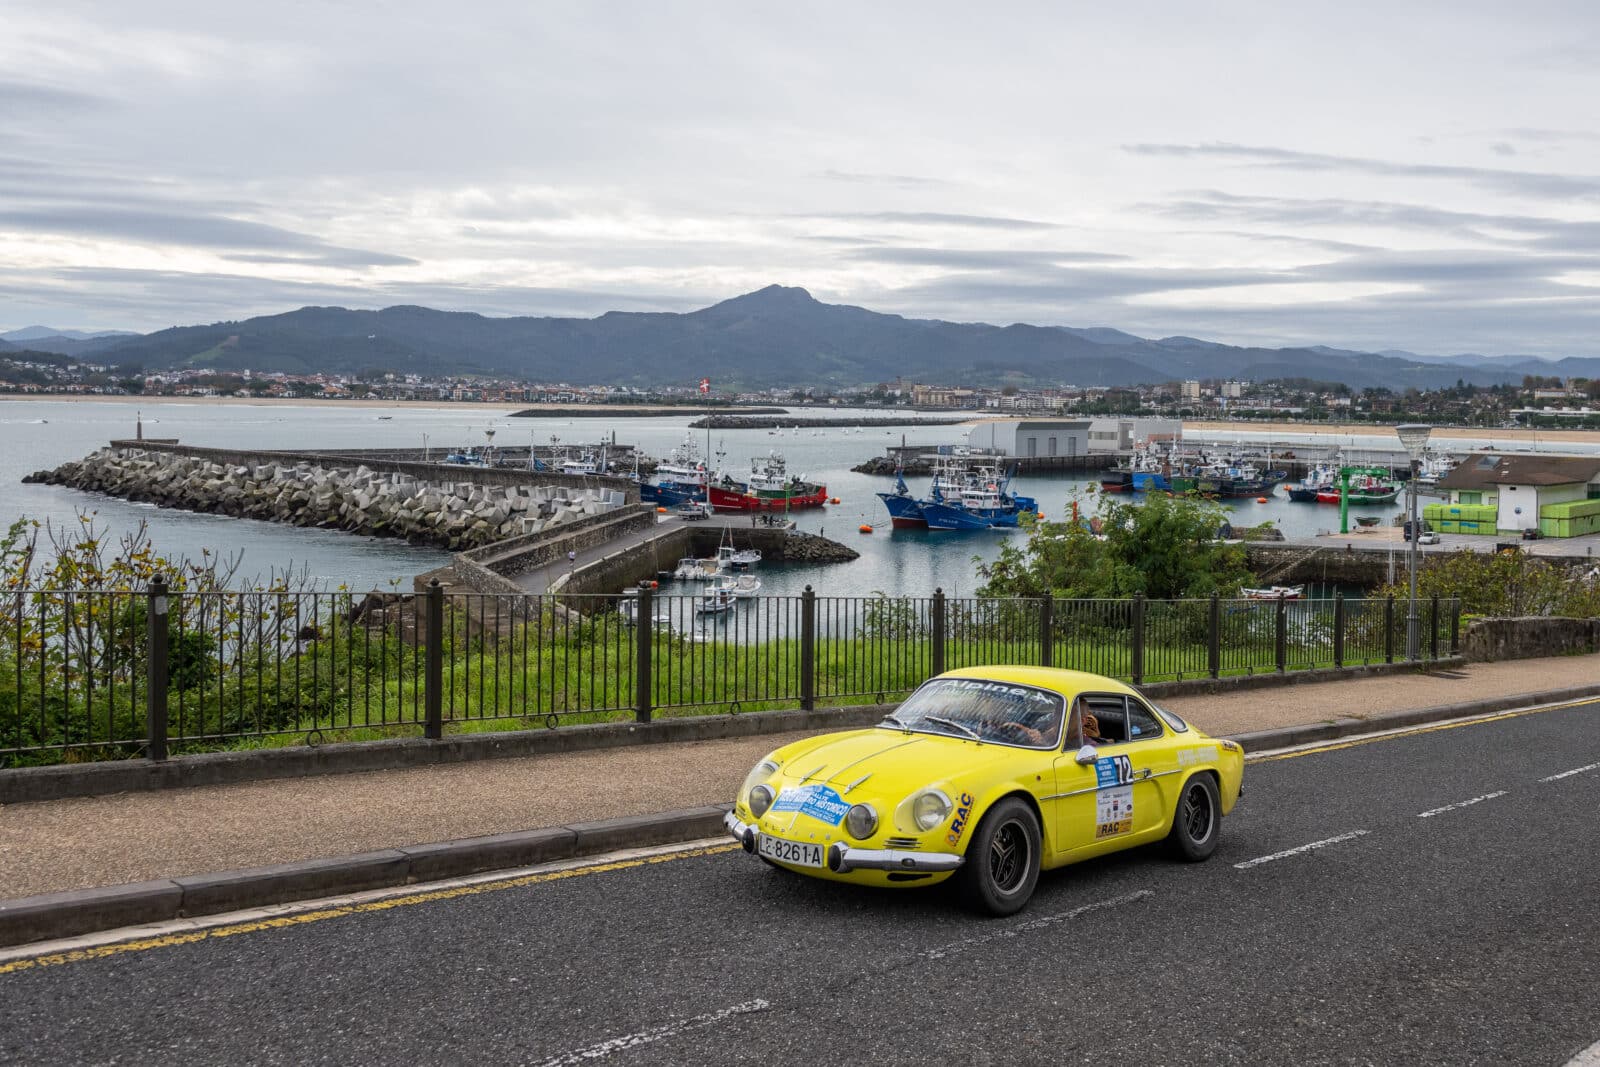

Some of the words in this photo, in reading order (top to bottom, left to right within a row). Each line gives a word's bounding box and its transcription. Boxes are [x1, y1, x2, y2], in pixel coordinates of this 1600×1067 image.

[943, 680, 1027, 696] Alpine
[1113, 756, 1134, 785] 72
[951, 793, 971, 833] RAC
[1101, 822, 1120, 834] RAC
